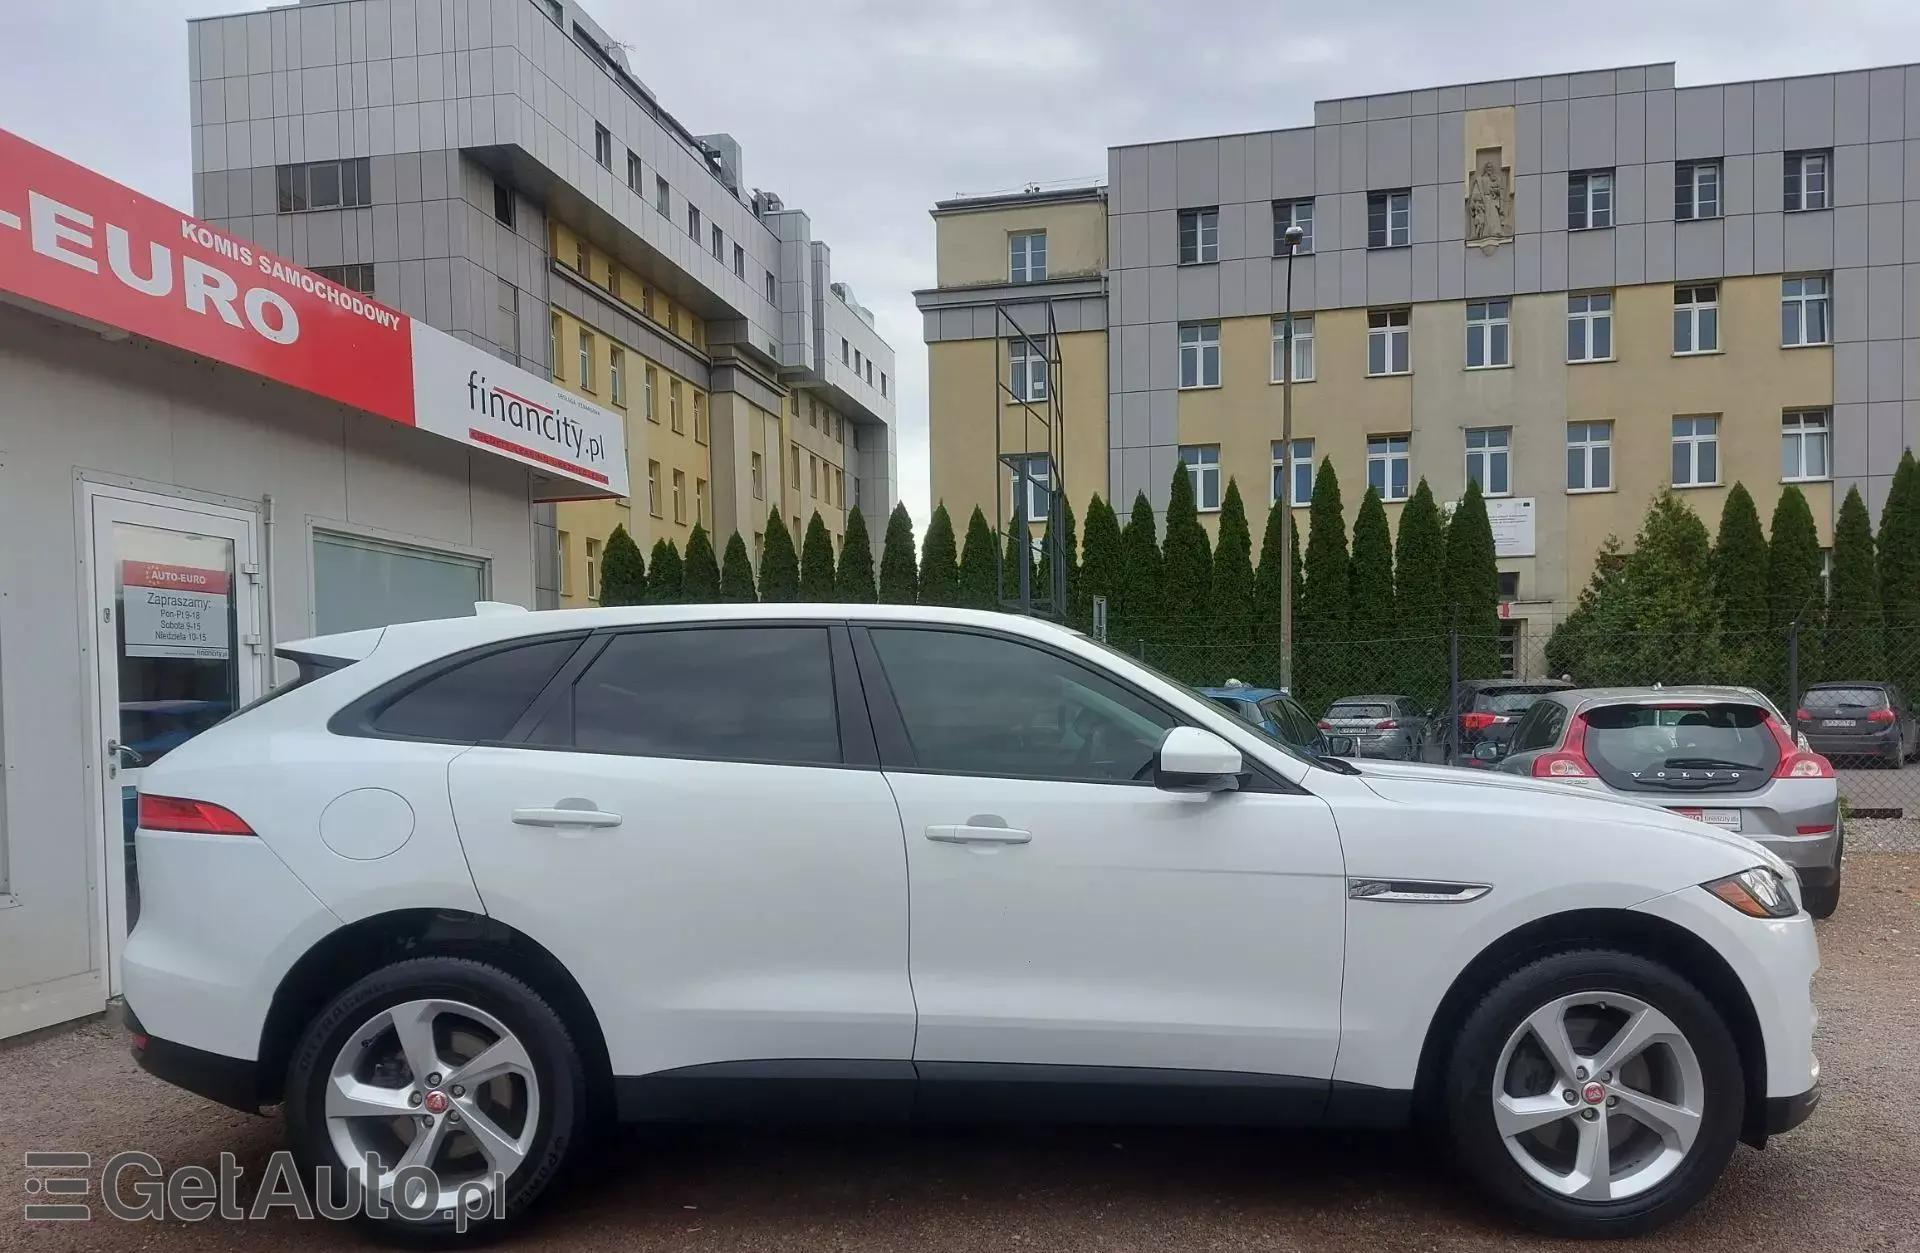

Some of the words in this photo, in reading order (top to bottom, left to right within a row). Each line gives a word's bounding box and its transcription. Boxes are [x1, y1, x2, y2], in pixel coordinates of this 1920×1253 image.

[181, 219, 253, 266] KOMIS
[258, 256, 400, 332] SAMOCHODOWY
[467, 370, 605, 462] financity.pl
[151, 570, 206, 585] AUTO-EURO
[147, 592, 211, 611] Zapraszamy:
[160, 620, 185, 630] Sobota
[186, 622, 201, 631] 9-15
[155, 631, 187, 641] Niedziela
[188, 633, 207, 642] 10-15
[1631, 771, 1741, 779] VOLVO
